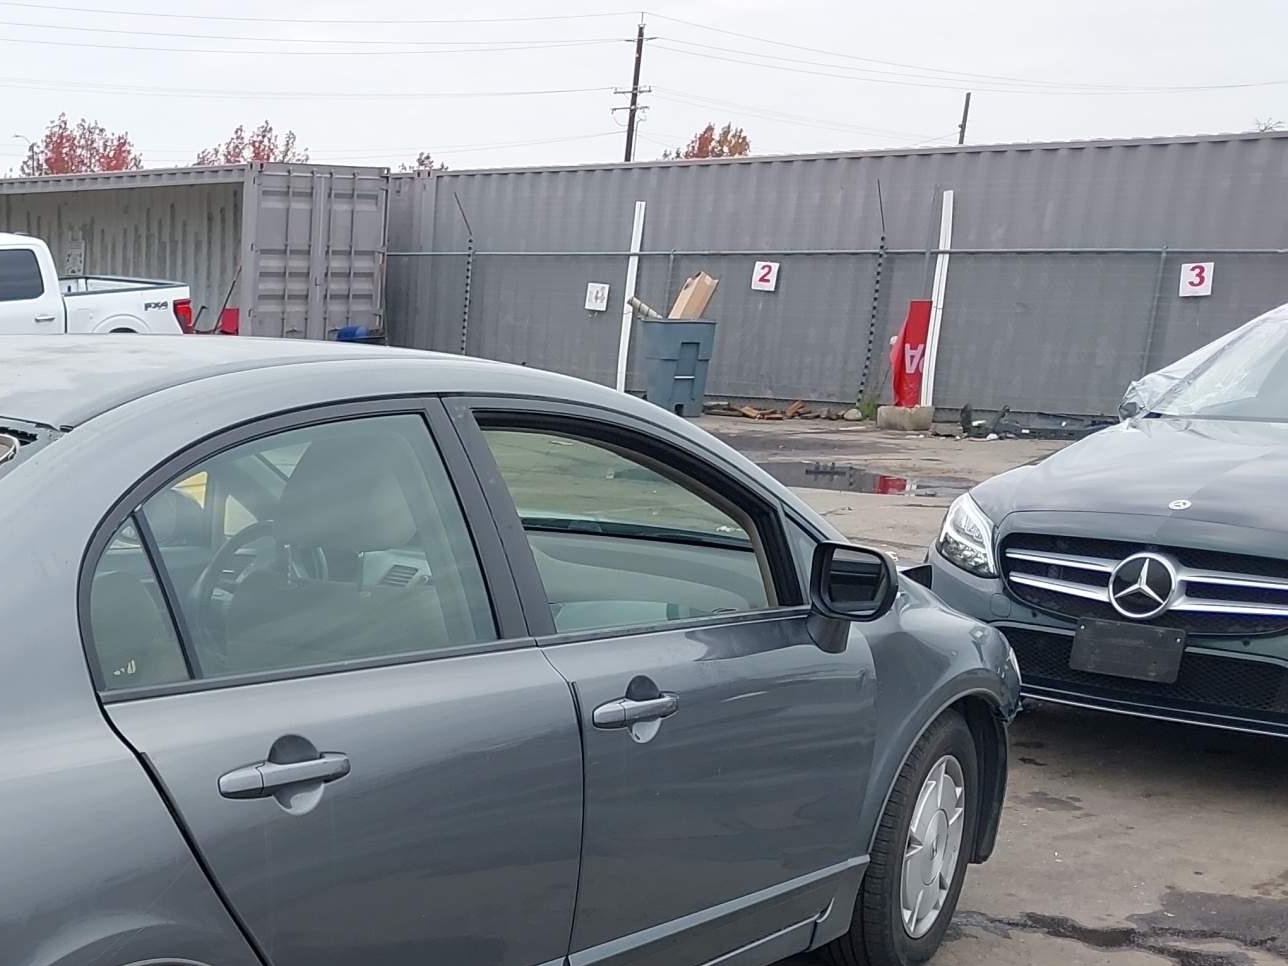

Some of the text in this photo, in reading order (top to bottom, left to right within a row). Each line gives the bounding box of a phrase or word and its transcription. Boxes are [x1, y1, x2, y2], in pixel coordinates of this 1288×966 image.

[758, 264, 772, 283] 2
[1188, 264, 1206, 287] 3
[144, 301, 169, 311] FX4
